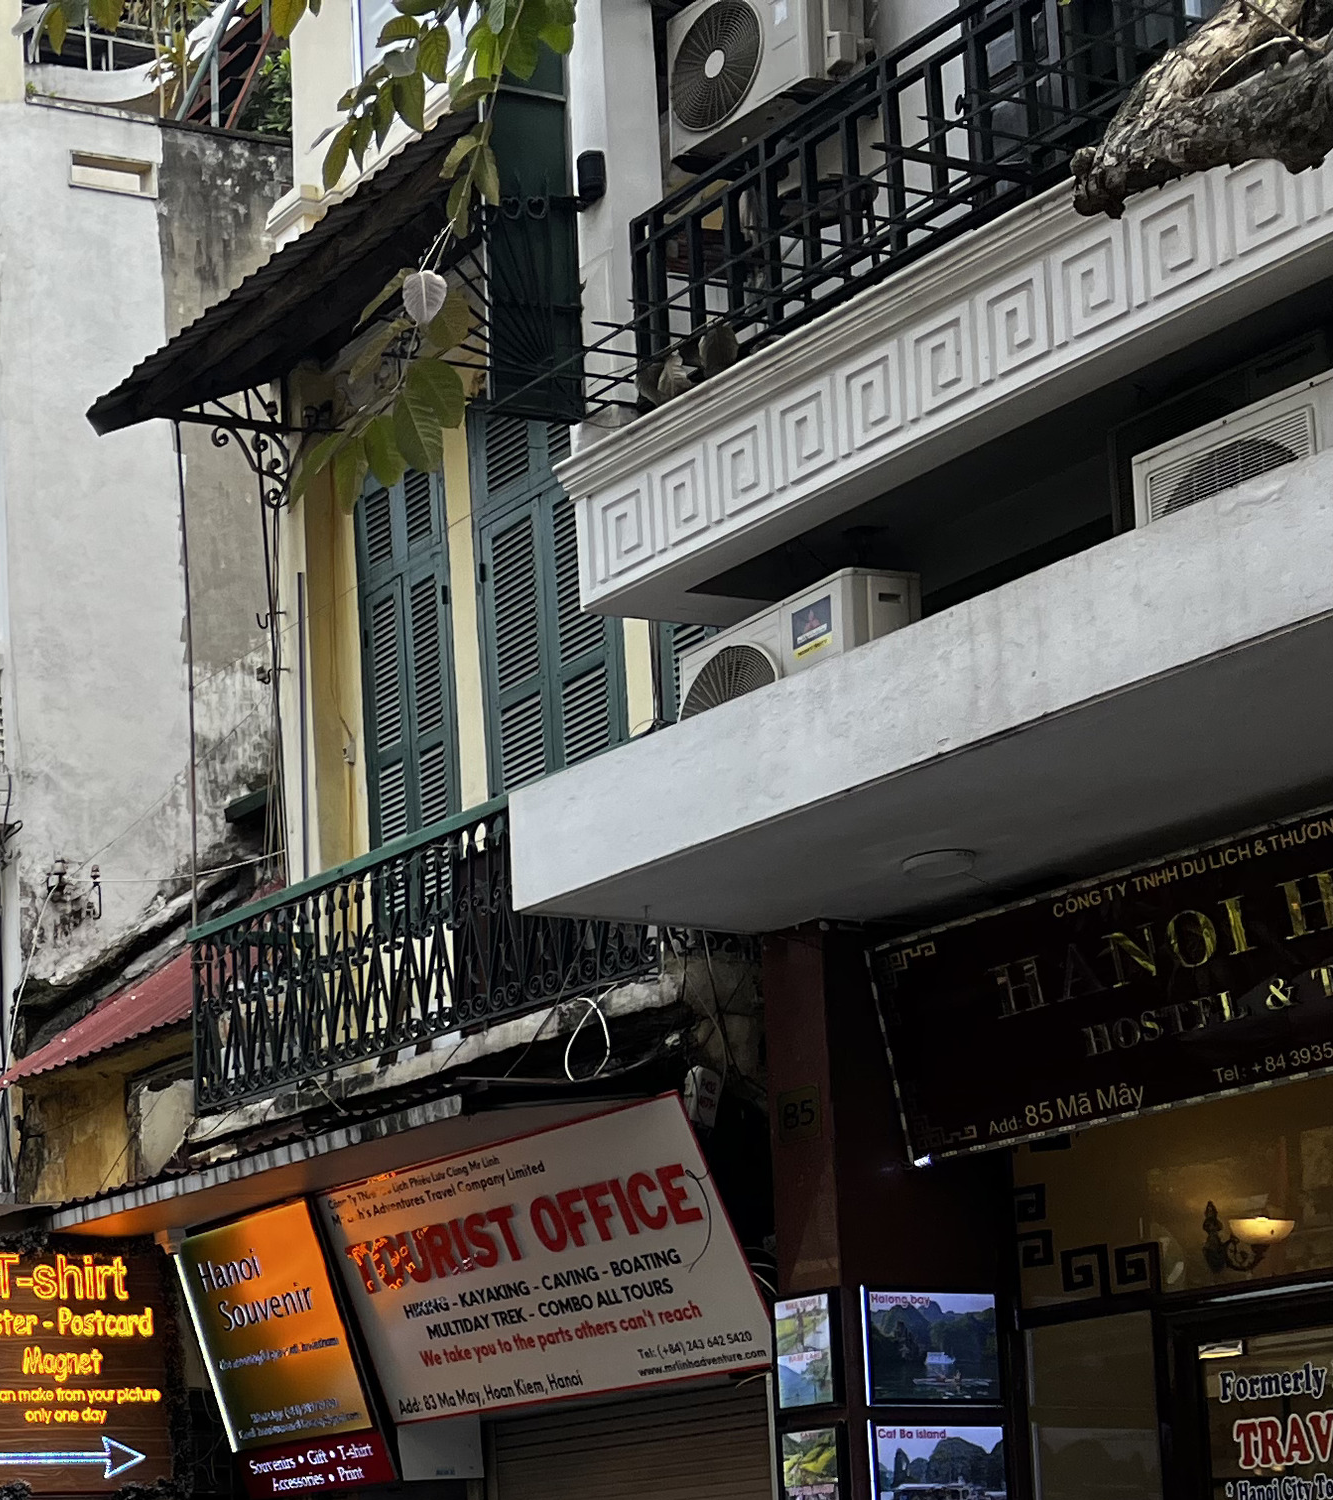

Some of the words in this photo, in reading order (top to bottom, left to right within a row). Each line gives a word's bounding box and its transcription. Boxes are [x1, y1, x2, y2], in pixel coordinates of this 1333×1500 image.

[1052, 890, 1102, 918] CÔNG
[1103, 881, 1128, 902] TY
[1132, 866, 1179, 894] TNHH
[1181, 857, 1206, 878] DU
[1254, 839, 1268, 856] &
[987, 895, 1258, 1020] HANOI
[1265, 978, 1295, 1010] &
[784, 1099, 815, 1130] 85
[1025, 1100, 1054, 1127] 85
[1056, 1093, 1092, 1121] Mã
[1096, 1083, 1145, 1112] Mây
[372, 1193, 426, 1216] Adventures
[426, 1183, 457, 1204] Travel
[456, 1173, 506, 1197] Company
[505, 1159, 546, 1182] Limited
[345, 1203, 522, 1295] TOURIST
[530, 1164, 704, 1252] OFFICE
[196, 1247, 263, 1293] Hanoi
[402, 1294, 450, 1320] HIKING
[458, 1280, 530, 1308] KAYAKING
[542, 1265, 600, 1291] CAVING
[609, 1247, 683, 1277] BOATING
[57, 1305, 155, 1338] Postcard
[218, 1281, 314, 1332] Souvenir
[426, 1312, 491, 1341] MULTIDAY
[492, 1304, 528, 1328] TREK
[538, 1293, 594, 1319] COMBO
[596, 1287, 622, 1309] ALL
[621, 1276, 675, 1304] TOURS
[419, 1347, 443, 1370] We
[443, 1341, 473, 1366] take
[474, 1341, 497, 1367] you
[497, 1336, 512, 1355] to
[512, 1332, 536, 1352] the
[537, 1326, 574, 1353] parts
[574, 1317, 618, 1342] others
[619, 1308, 657, 1334] can't
[657, 1299, 703, 1326] reach
[637, 1343, 657, 1361] Tel:
[657, 1338, 685, 1360] (+84)
[685, 1336, 705, 1351] 243
[706, 1333, 726, 1349] 642
[21, 1345, 104, 1383] Magnet
[1219, 1362, 1326, 1402] Formerly
[18, 1386, 54, 1403] make
[55, 1386, 86, 1403] from
[86, 1389, 115, 1405] your
[116, 1386, 162, 1405] picture
[398, 1396, 424, 1416] Add:
[423, 1393, 438, 1411] 83
[437, 1391, 457, 1410] Ma
[457, 1387, 485, 1409] May,
[484, 1382, 515, 1403] Hoan
[515, 1375, 548, 1399] Kiem,
[548, 1369, 583, 1394] Hanoi
[24, 1407, 52, 1425] only
[53, 1409, 79, 1423] one
[81, 1407, 107, 1425] day
[877, 1428, 896, 1439] Cat
[899, 1428, 913, 1439] Ba
[249, 1454, 297, 1475] Souvenirs
[306, 1447, 329, 1466] Gift
[336, 1442, 374, 1461] T-shirt
[272, 1471, 325, 1493] Accessories
[336, 1463, 366, 1483] Print
